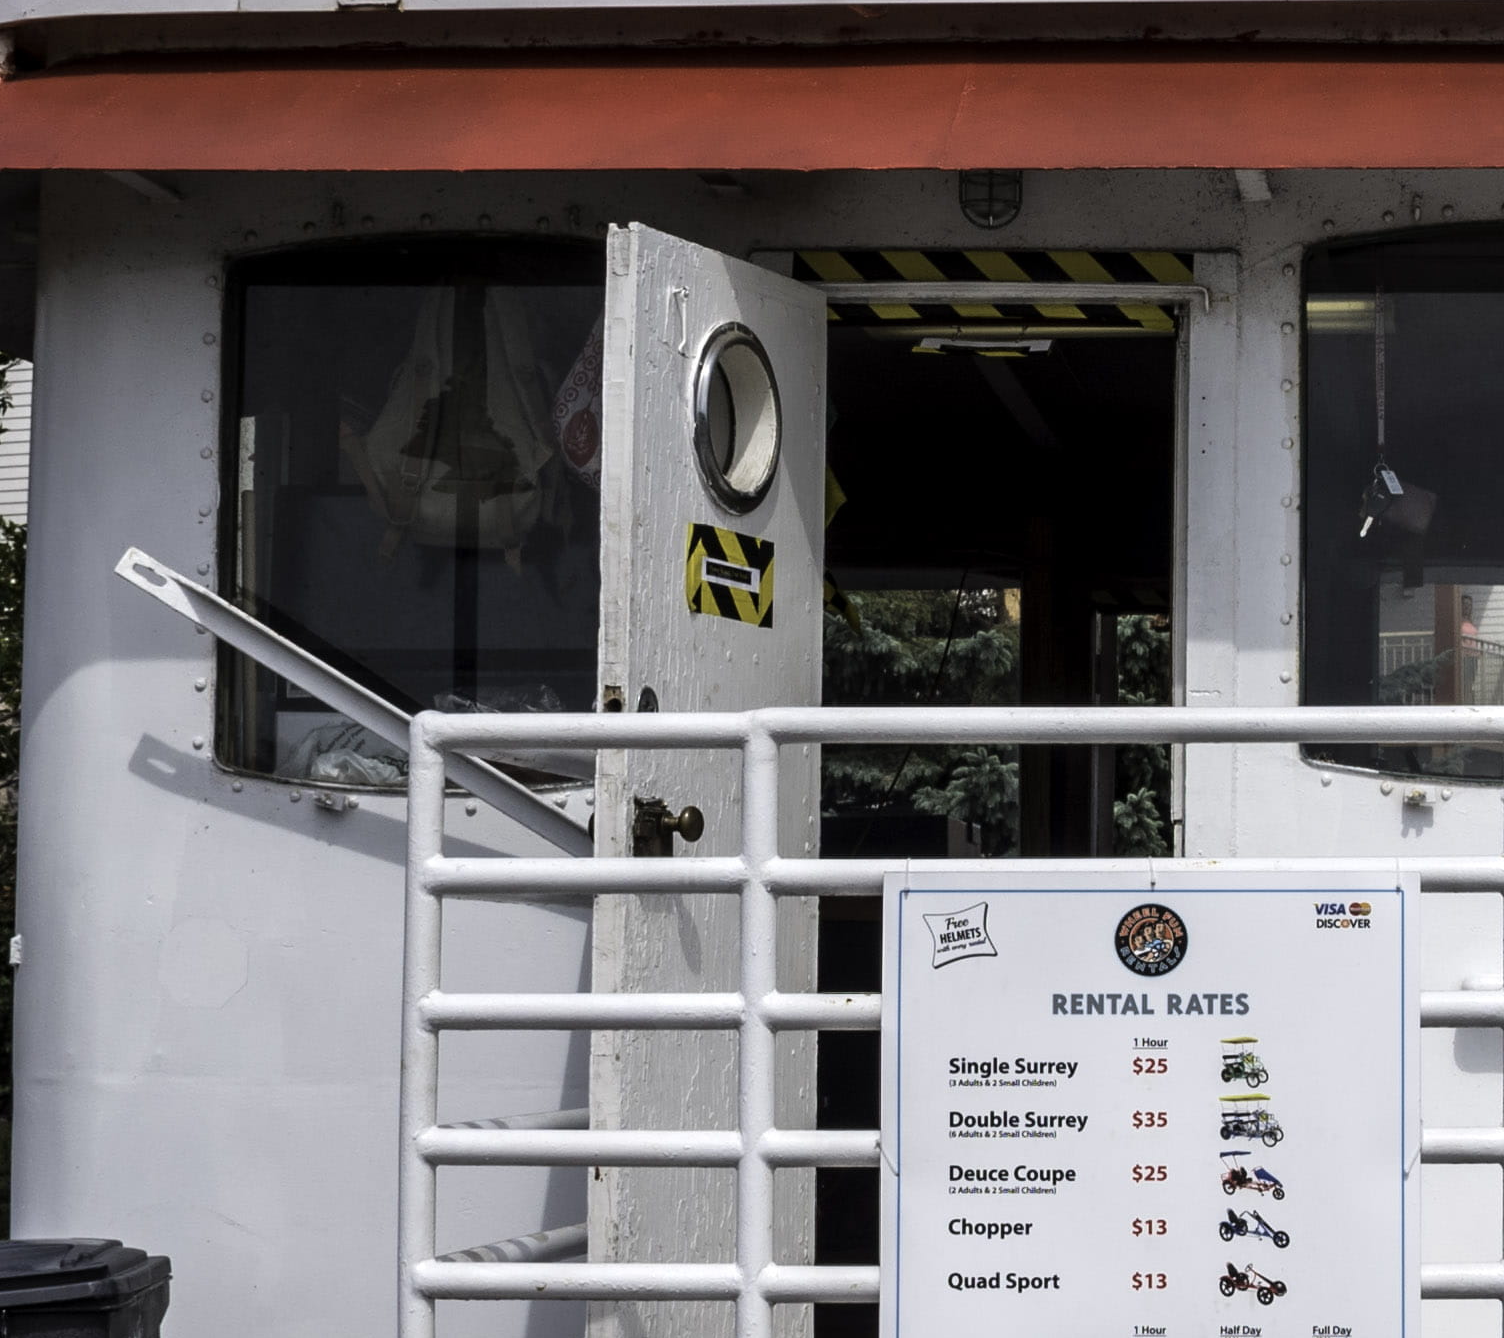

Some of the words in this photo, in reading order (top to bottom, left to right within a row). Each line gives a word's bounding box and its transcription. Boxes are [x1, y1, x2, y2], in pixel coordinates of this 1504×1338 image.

[1313, 903, 1346, 915] VISA
[944, 917, 969, 930] Free
[1316, 918, 1371, 929] DISCOVER
[939, 927, 981, 944] HELMETS
[1120, 945, 1181, 973] RENTALS
[1052, 994, 1155, 1016] RENTAL
[1167, 993, 1250, 1016] RATES
[1141, 1037, 1169, 1047] Hour
[949, 1057, 1010, 1079] Single
[1015, 1057, 1078, 1079] Surrey
[1132, 1057, 1168, 1076] $25
[958, 1079, 983, 1088] Adults
[949, 1111, 1019, 1129] Double
[1024, 1111, 1088, 1133] Surrey
[1132, 1111, 1168, 1130] $35
[958, 1130, 983, 1139] Adults
[949, 1165, 1010, 1182] Deuce
[1014, 1165, 1076, 1186] Coupe
[1132, 1165, 1168, 1184] $25
[958, 1186, 983, 1195] Adults
[948, 1218, 1033, 1240] Chopper
[1132, 1218, 1168, 1238] $13
[948, 1272, 1001, 1292] Quad
[1006, 1272, 1060, 1294] Sport
[1132, 1272, 1168, 1291] $13
[1141, 1325, 1167, 1335] Hour
[1220, 1325, 1239, 1335] Half
[1242, 1325, 1262, 1337] Day
[1312, 1325, 1331, 1335] Full
[1333, 1325, 1352, 1337] Day
